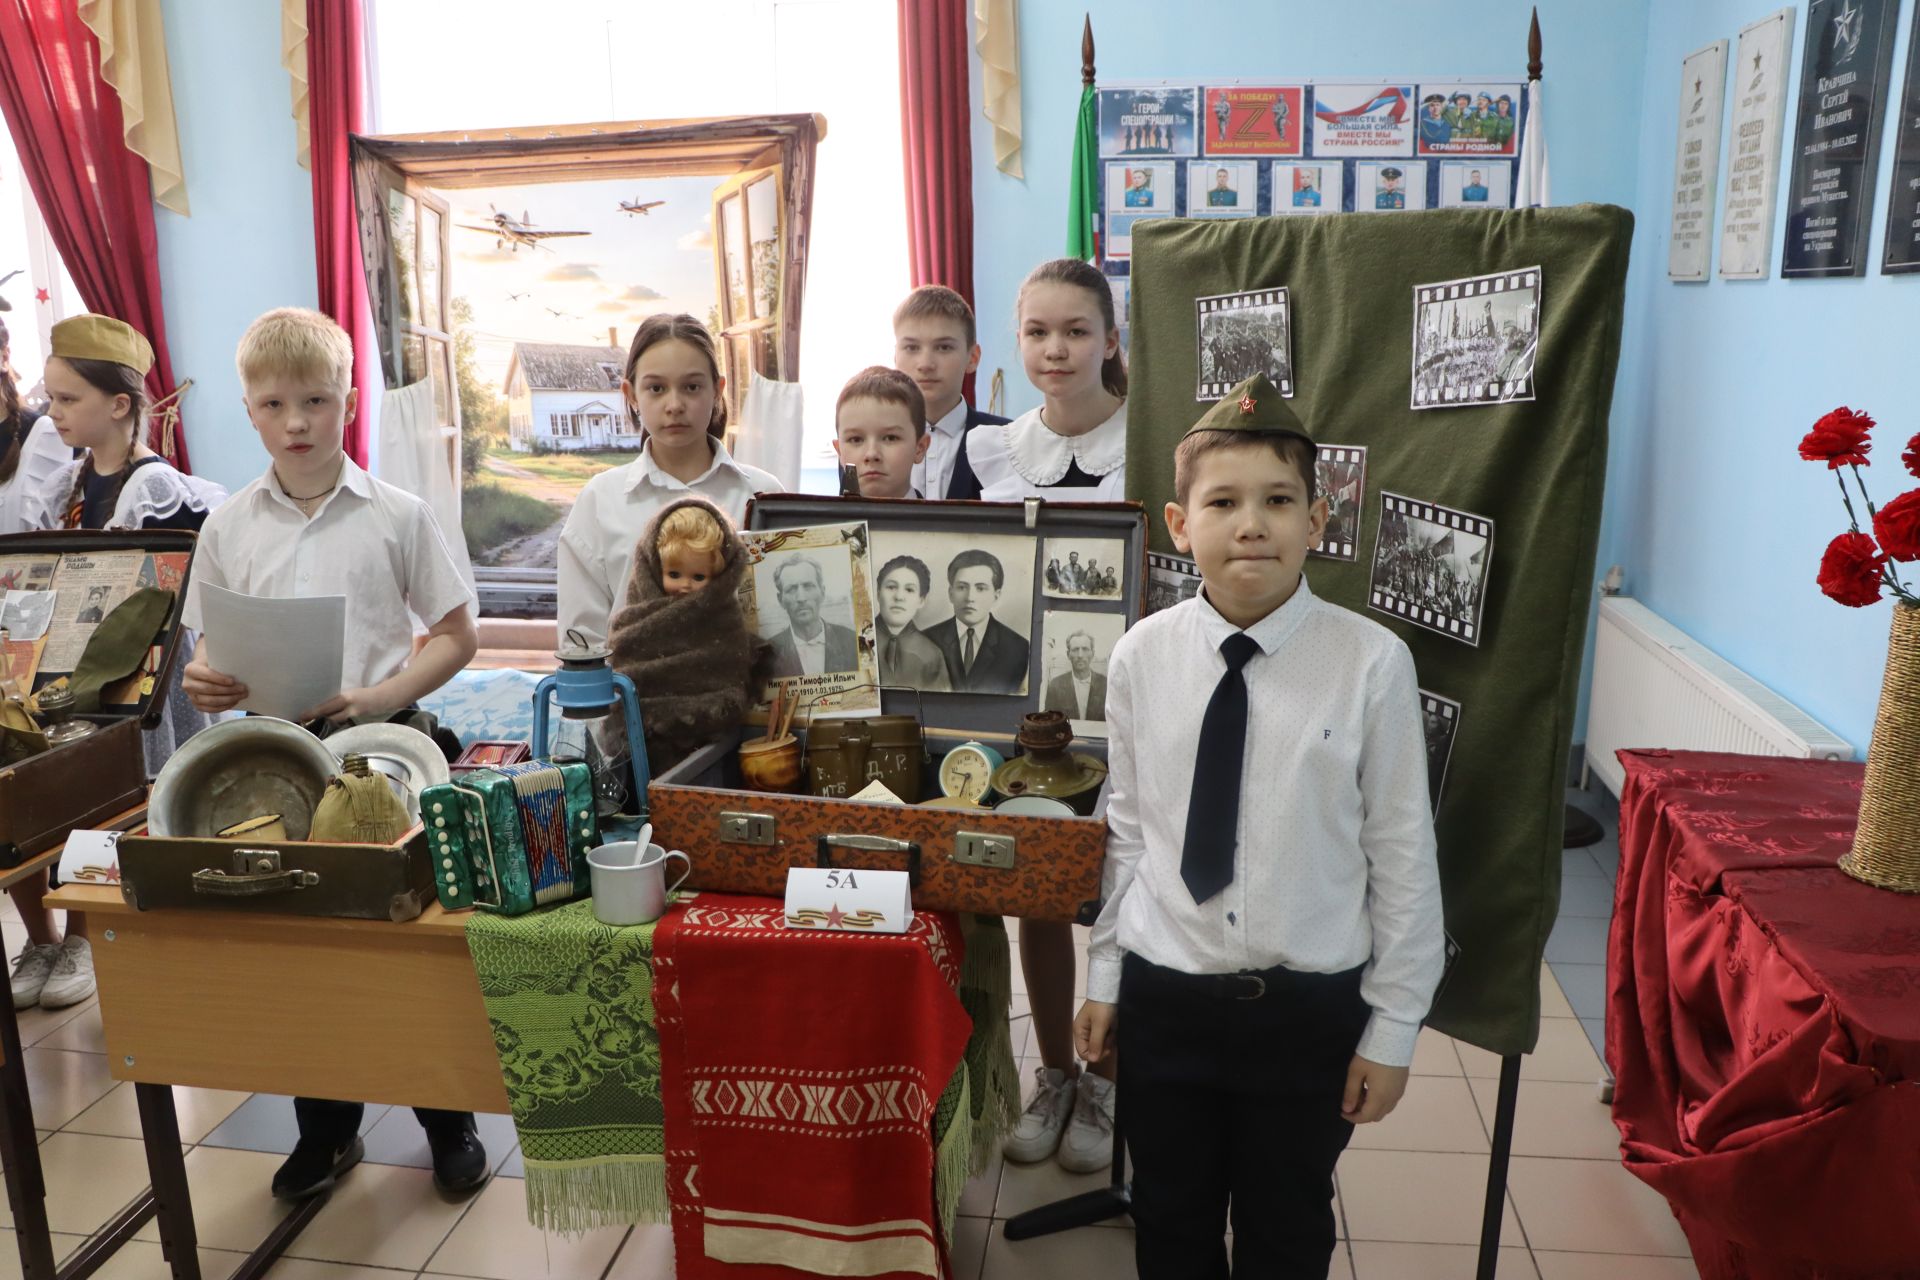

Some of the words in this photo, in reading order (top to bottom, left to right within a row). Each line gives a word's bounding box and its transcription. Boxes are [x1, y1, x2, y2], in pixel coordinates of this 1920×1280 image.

[1138, 103, 1159, 114] ГЕРОИ
[1327, 123, 1372, 131] БОЛЬШАЯ
[1429, 143, 1463, 151] СТРАНЫ
[1465, 141, 1502, 151] РОДНОЙ
[768, 679, 798, 689] Никин
[799, 675, 832, 686] Тимофей
[833, 673, 856, 683] Ильич
[825, 869, 859, 889] 5А
